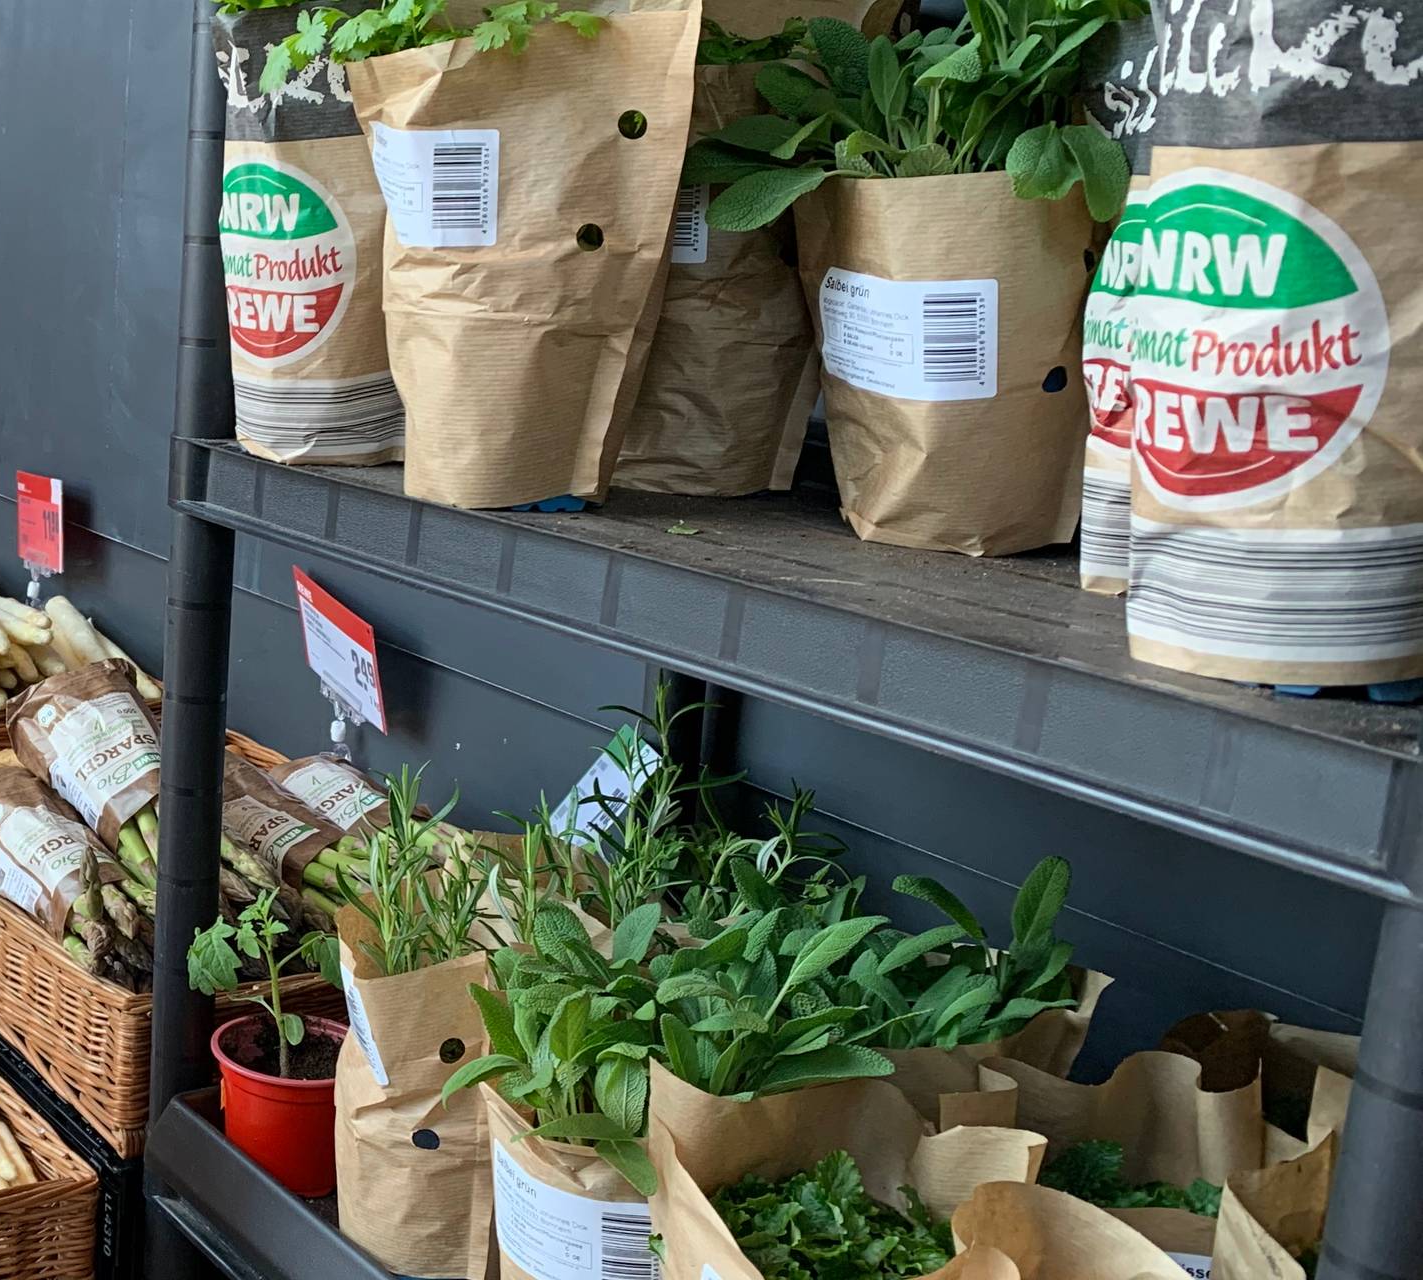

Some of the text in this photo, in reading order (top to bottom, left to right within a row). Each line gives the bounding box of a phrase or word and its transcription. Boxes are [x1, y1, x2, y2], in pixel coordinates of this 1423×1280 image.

[825, 276, 870, 298] Salbei grün
[1100, 240, 1143, 291] NR
[1140, 228, 1287, 297] NRW
[1134, 381, 1319, 455] REWE
[75, 734, 156, 782] SPARGEL
